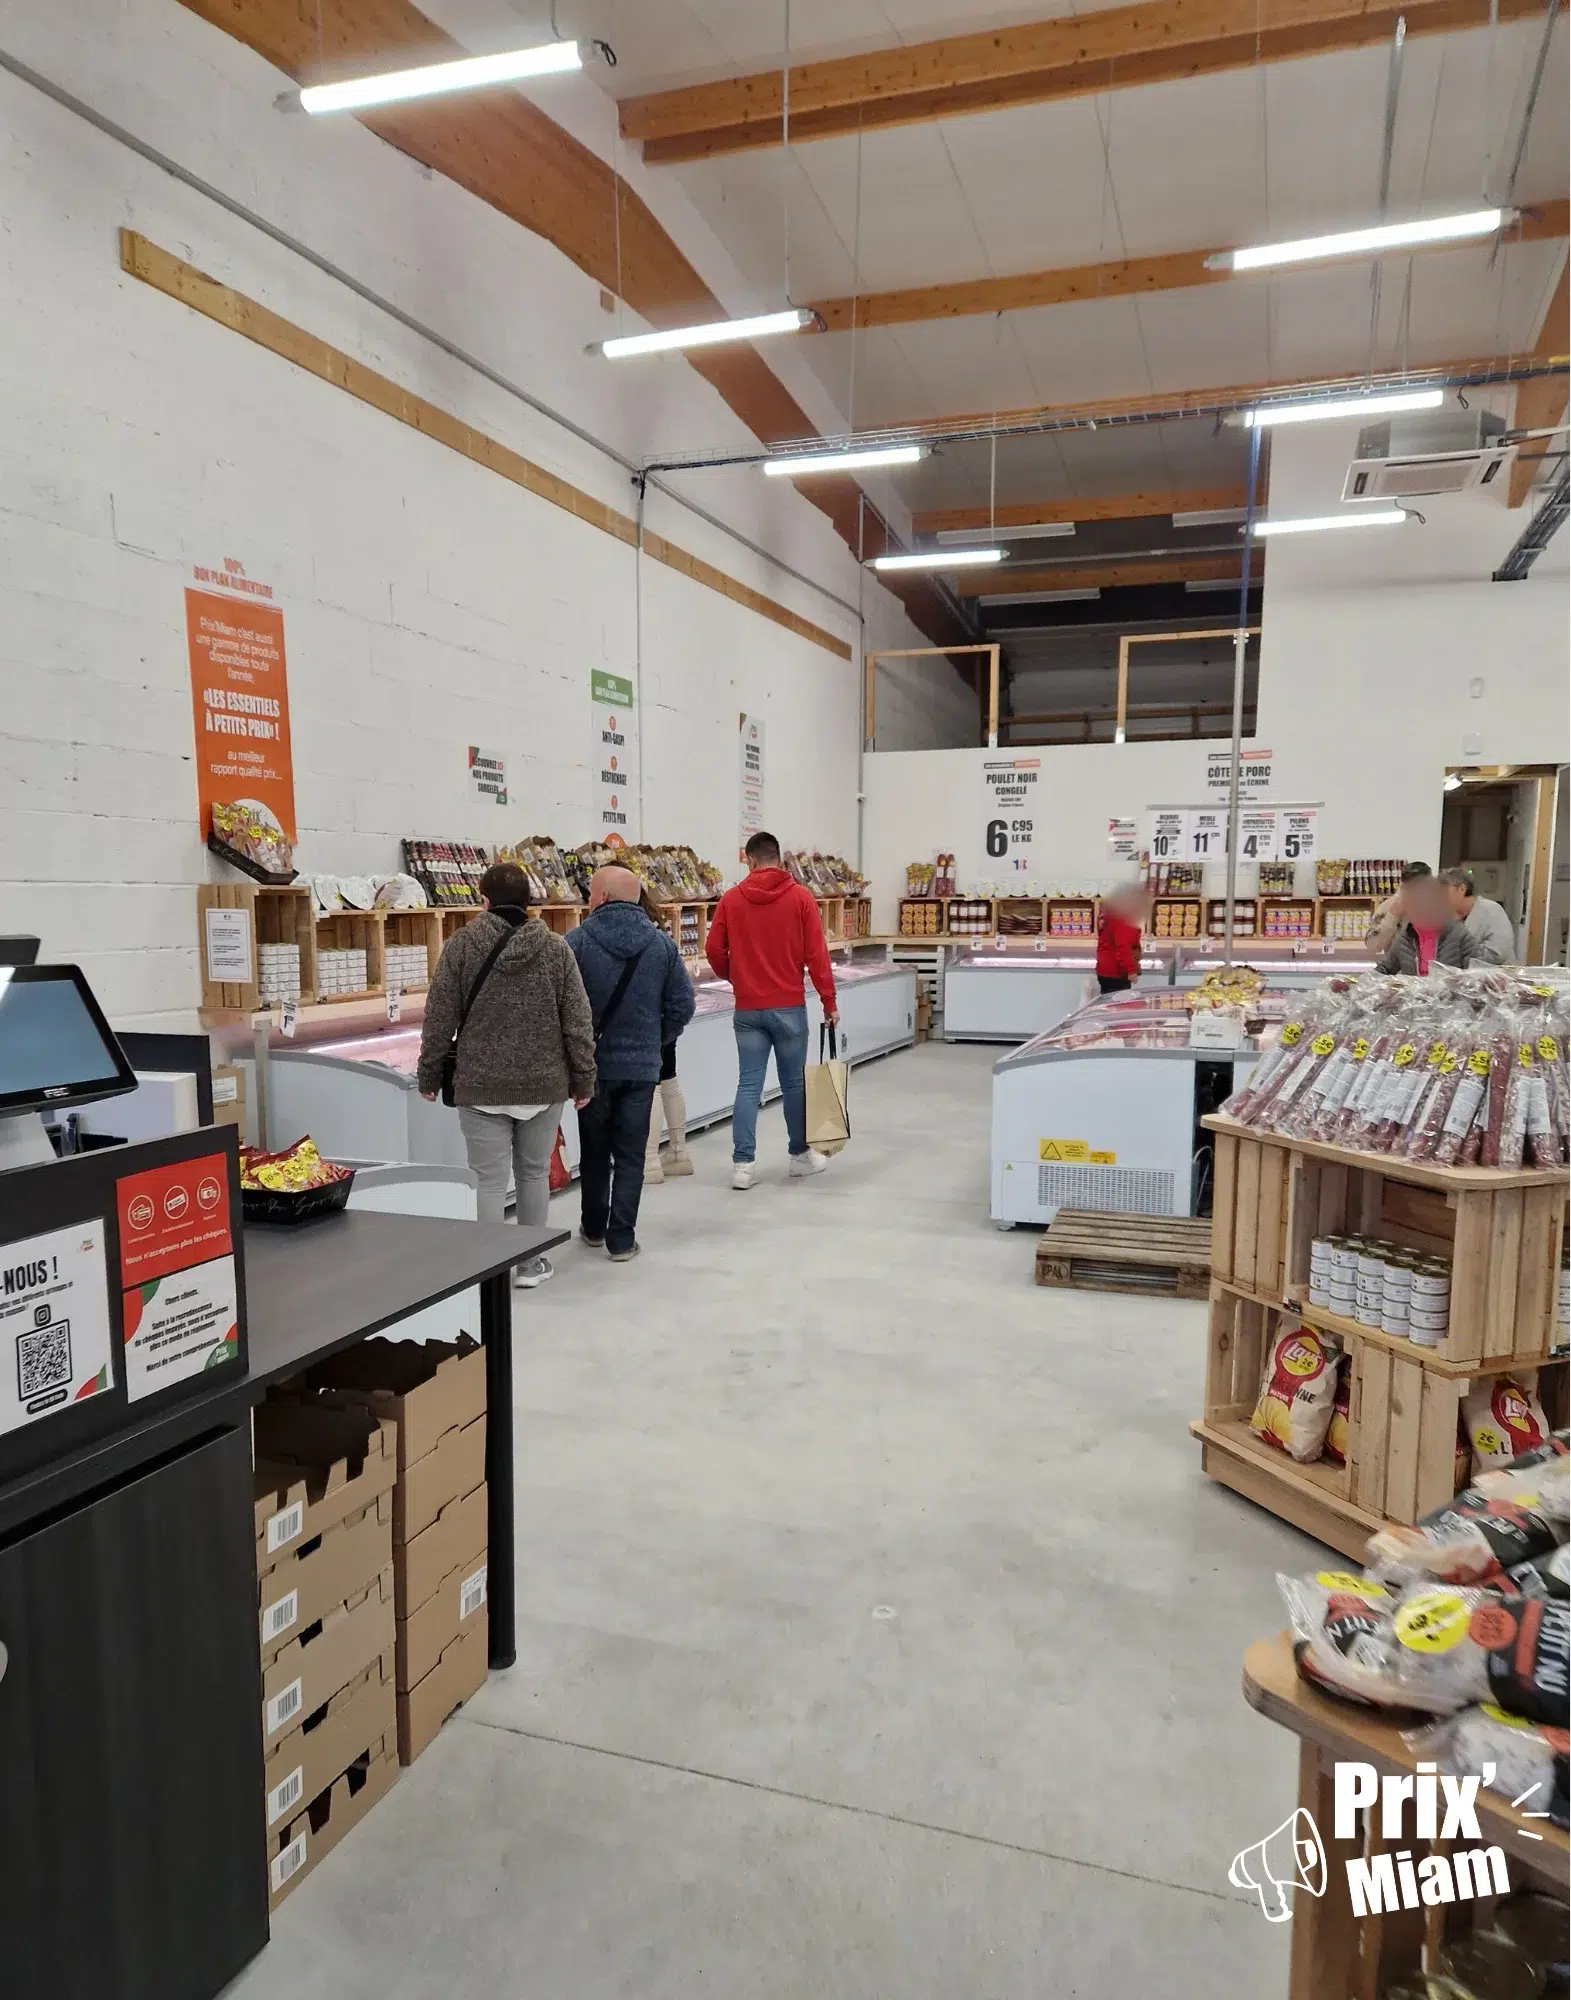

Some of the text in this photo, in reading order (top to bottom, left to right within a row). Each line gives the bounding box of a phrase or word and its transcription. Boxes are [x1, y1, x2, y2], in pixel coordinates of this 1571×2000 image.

[255, 632, 273, 645] aussi
[212, 636, 240, 650] gamme
[240, 642, 250, 654] de
[251, 645, 280, 660] produits
[210, 650, 250, 668] disponibles
[227, 691, 280, 718] ESSENTIELS
[206, 709, 213, 732] À
[214, 713, 247, 736] PETITS
[602, 730, 625, 746] ANTI-GASPI
[228, 750, 266, 763] au meilleur
[210, 764, 238, 778] rapport
[472, 770, 504, 783] NOS PRODUITS
[986, 773, 1037, 784] POULET NOIR
[1208, 765, 1231, 778] CÔTE
[1246, 766, 1271, 777] PORC
[996, 785, 1027, 795] CONGELÉ
[603, 811, 626, 824] PETITS PRIX
[986, 820, 1008, 858] 6
[1012, 834, 1032, 843] LE KG
[1153, 836, 1168, 856] 10
[1193, 832, 1208, 853] 11
[1243, 835, 1258, 858] 4
[1285, 834, 1300, 858] 5
[126, 1255, 142, 1266] Nous
[144, 1243, 179, 1259] n'acceptons
[181, 1238, 193, 1250] plus
[194, 1234, 203, 1243] les
[53, 1256, 58, 1280] !
[165, 1296, 180, 1305] Chers
[142, 1331, 164, 1344] chèques
[188, 1317, 200, 1326] nous
[152, 1320, 165, 1330] Suite
[150, 1342, 161, 1352] plus
[169, 1334, 182, 1343] mode
[146, 1361, 161, 1372] Merci
[169, 1353, 182, 1362] votre
